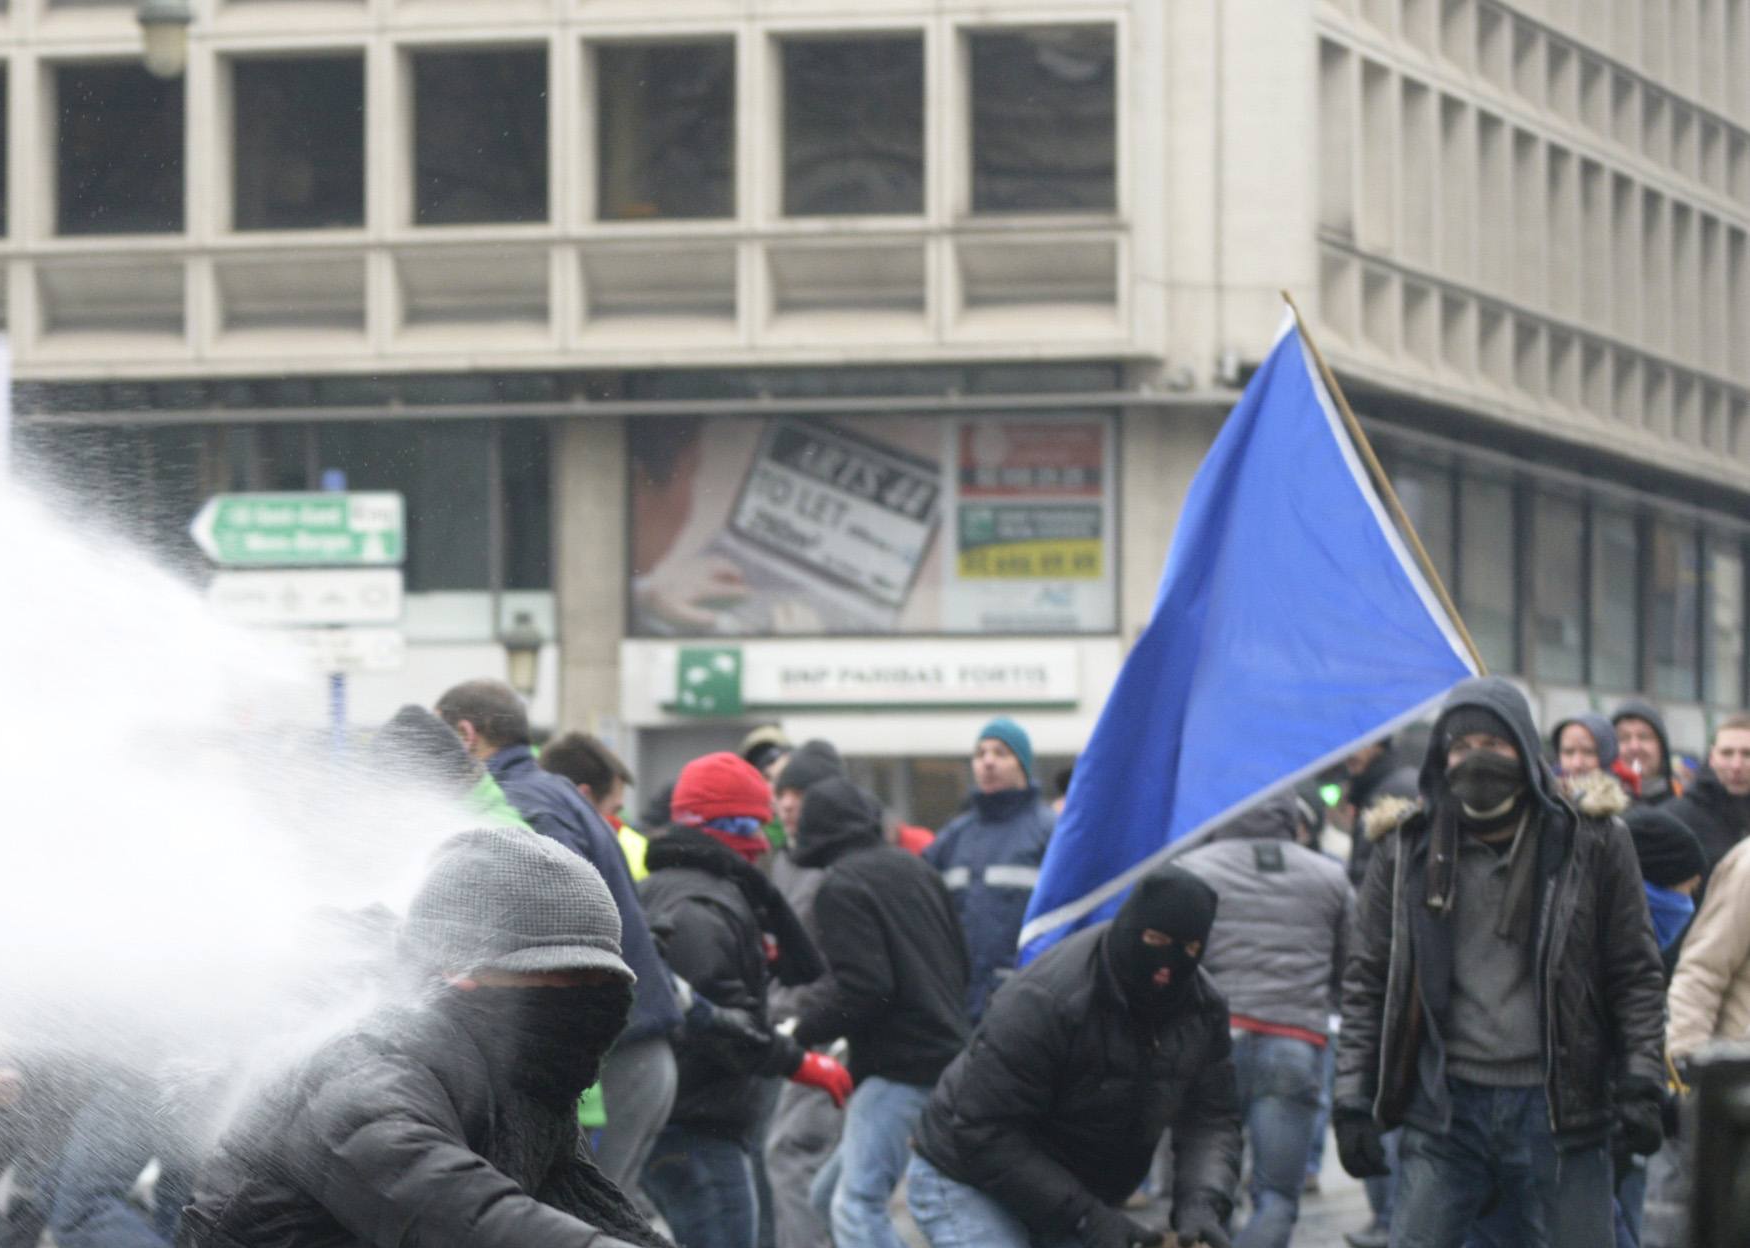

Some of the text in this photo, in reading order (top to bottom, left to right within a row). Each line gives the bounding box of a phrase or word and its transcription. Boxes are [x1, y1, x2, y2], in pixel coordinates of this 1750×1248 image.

[796, 483, 849, 527] LET
[780, 665, 1049, 685] BNP PARIBAS FORTIS
